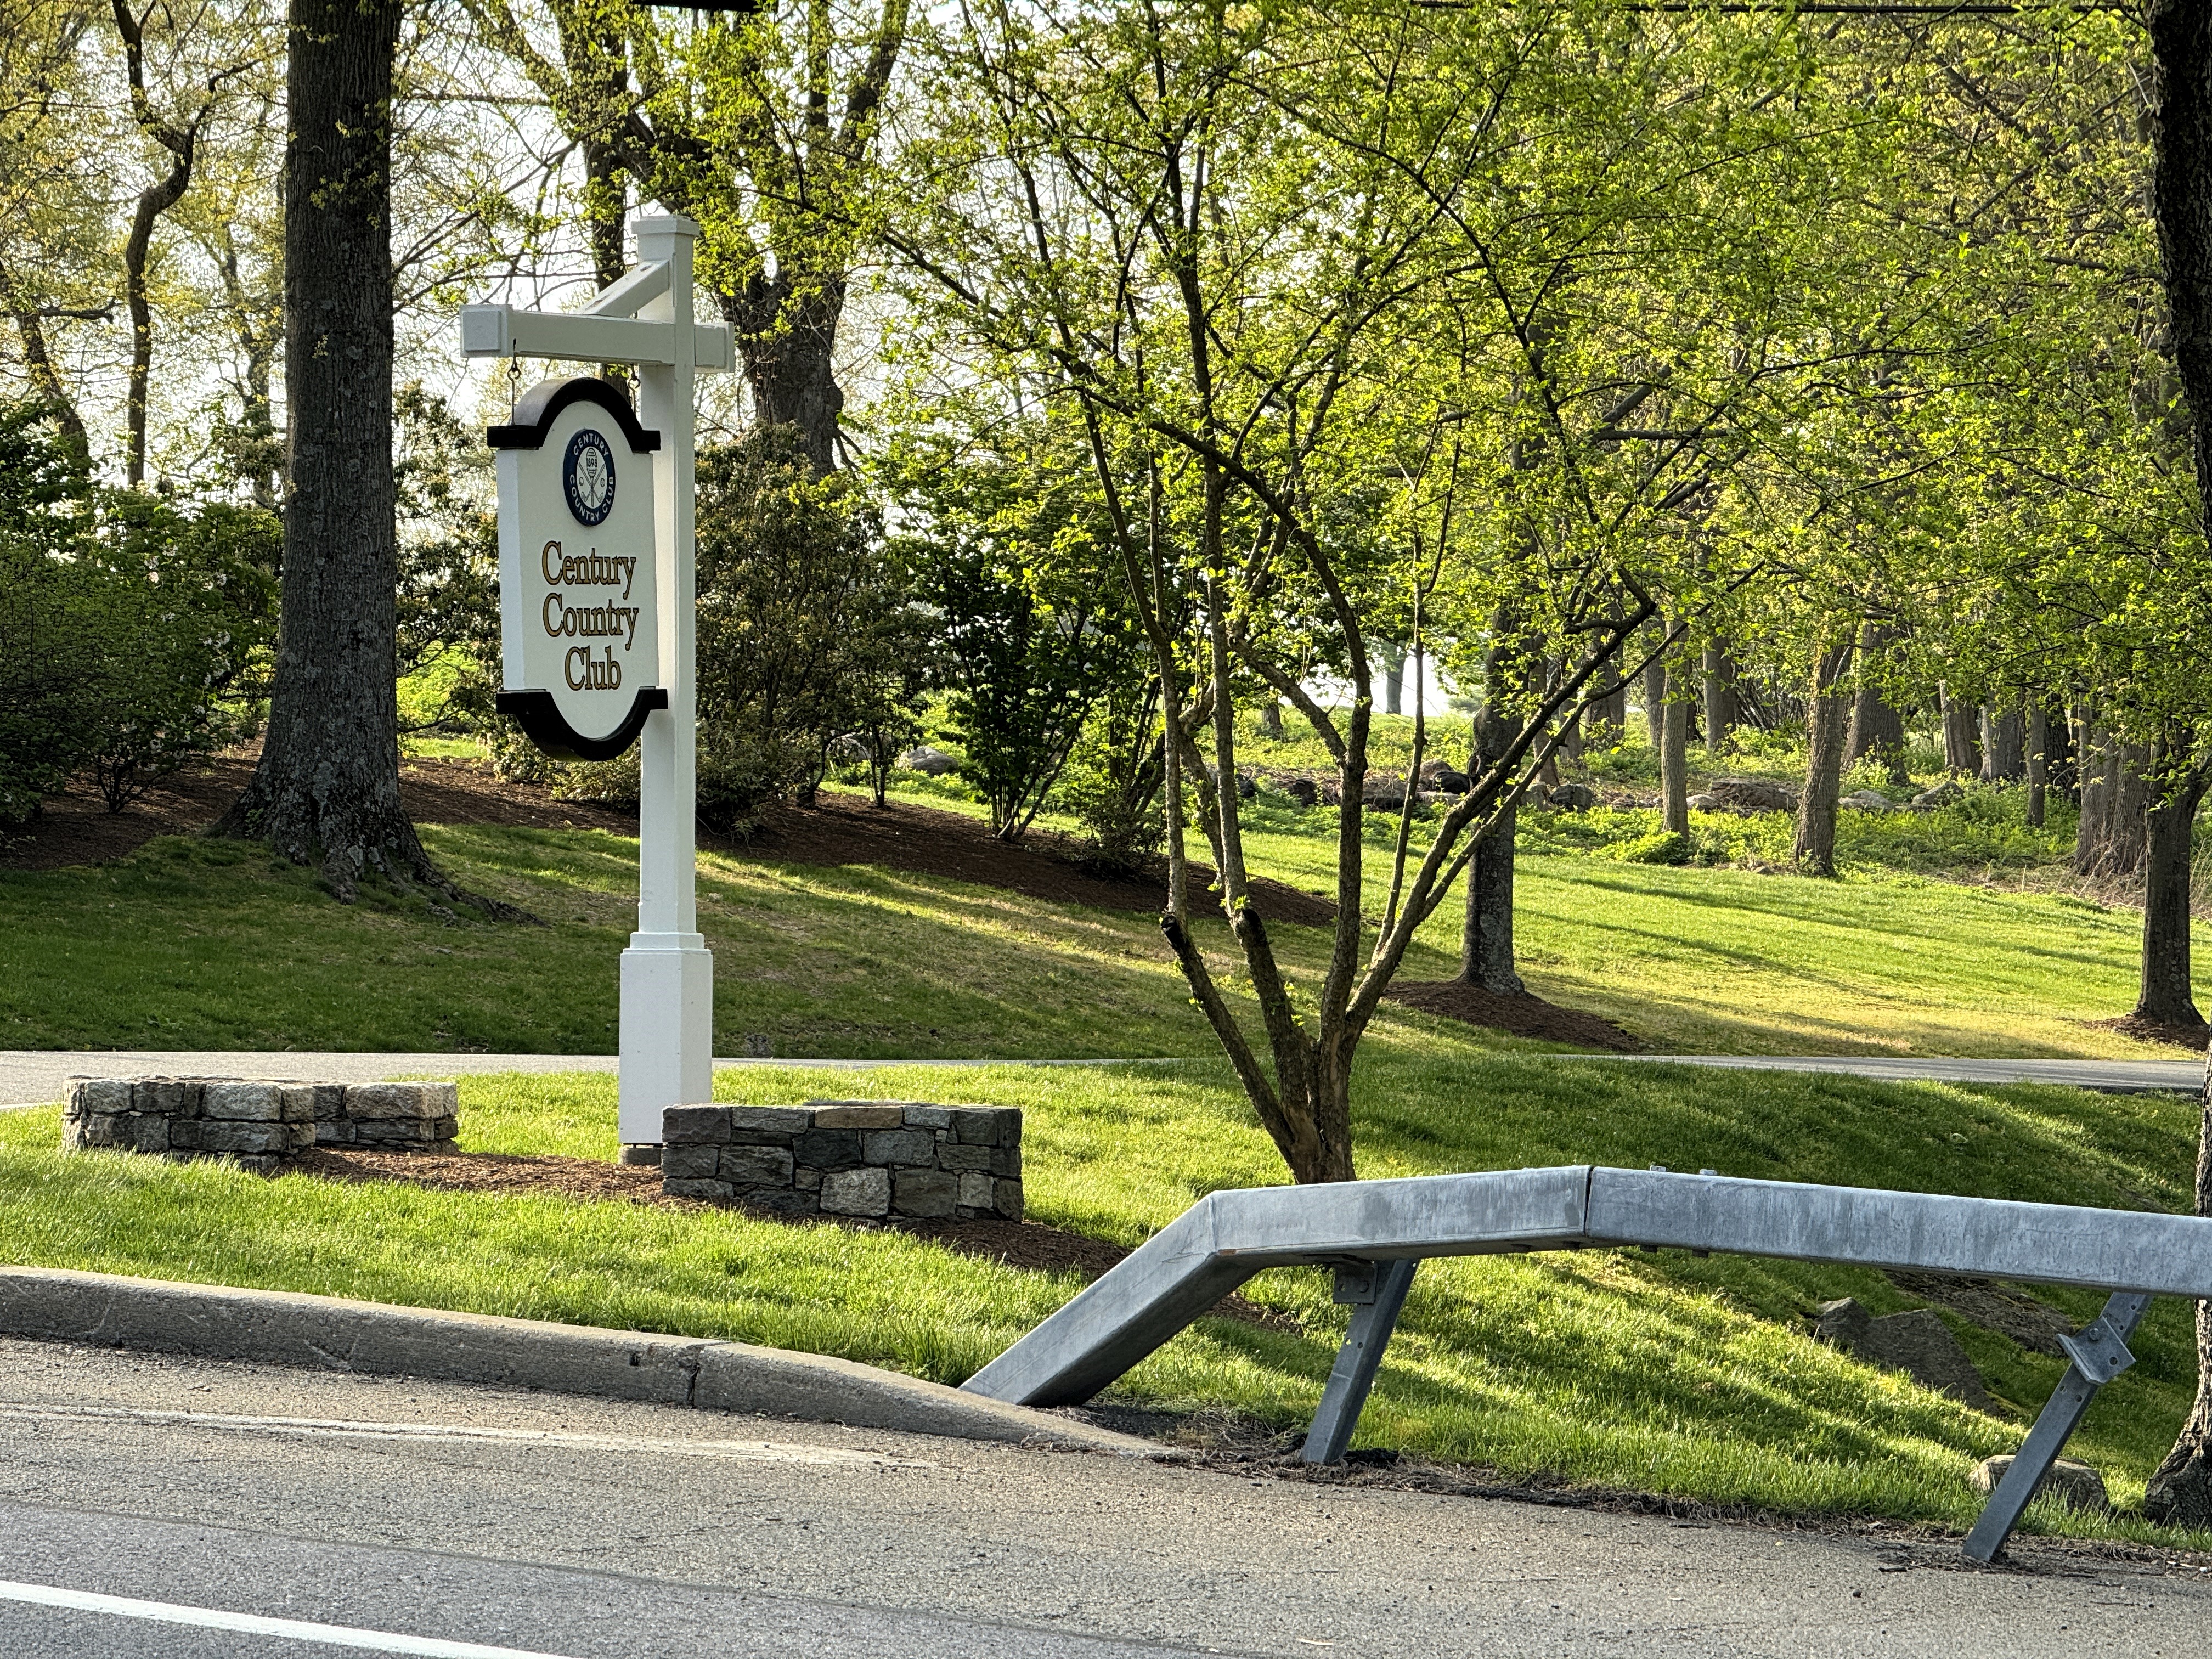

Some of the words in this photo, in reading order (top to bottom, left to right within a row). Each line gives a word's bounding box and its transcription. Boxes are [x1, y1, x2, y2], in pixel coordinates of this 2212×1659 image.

[574, 433, 609, 456] CENTURY
[569, 474, 600, 522] COUNTRY
[602, 476, 614, 513] CLUB
[542, 540, 636, 600] Century
[543, 592, 639, 651] Country
[565, 645, 621, 691] Club
